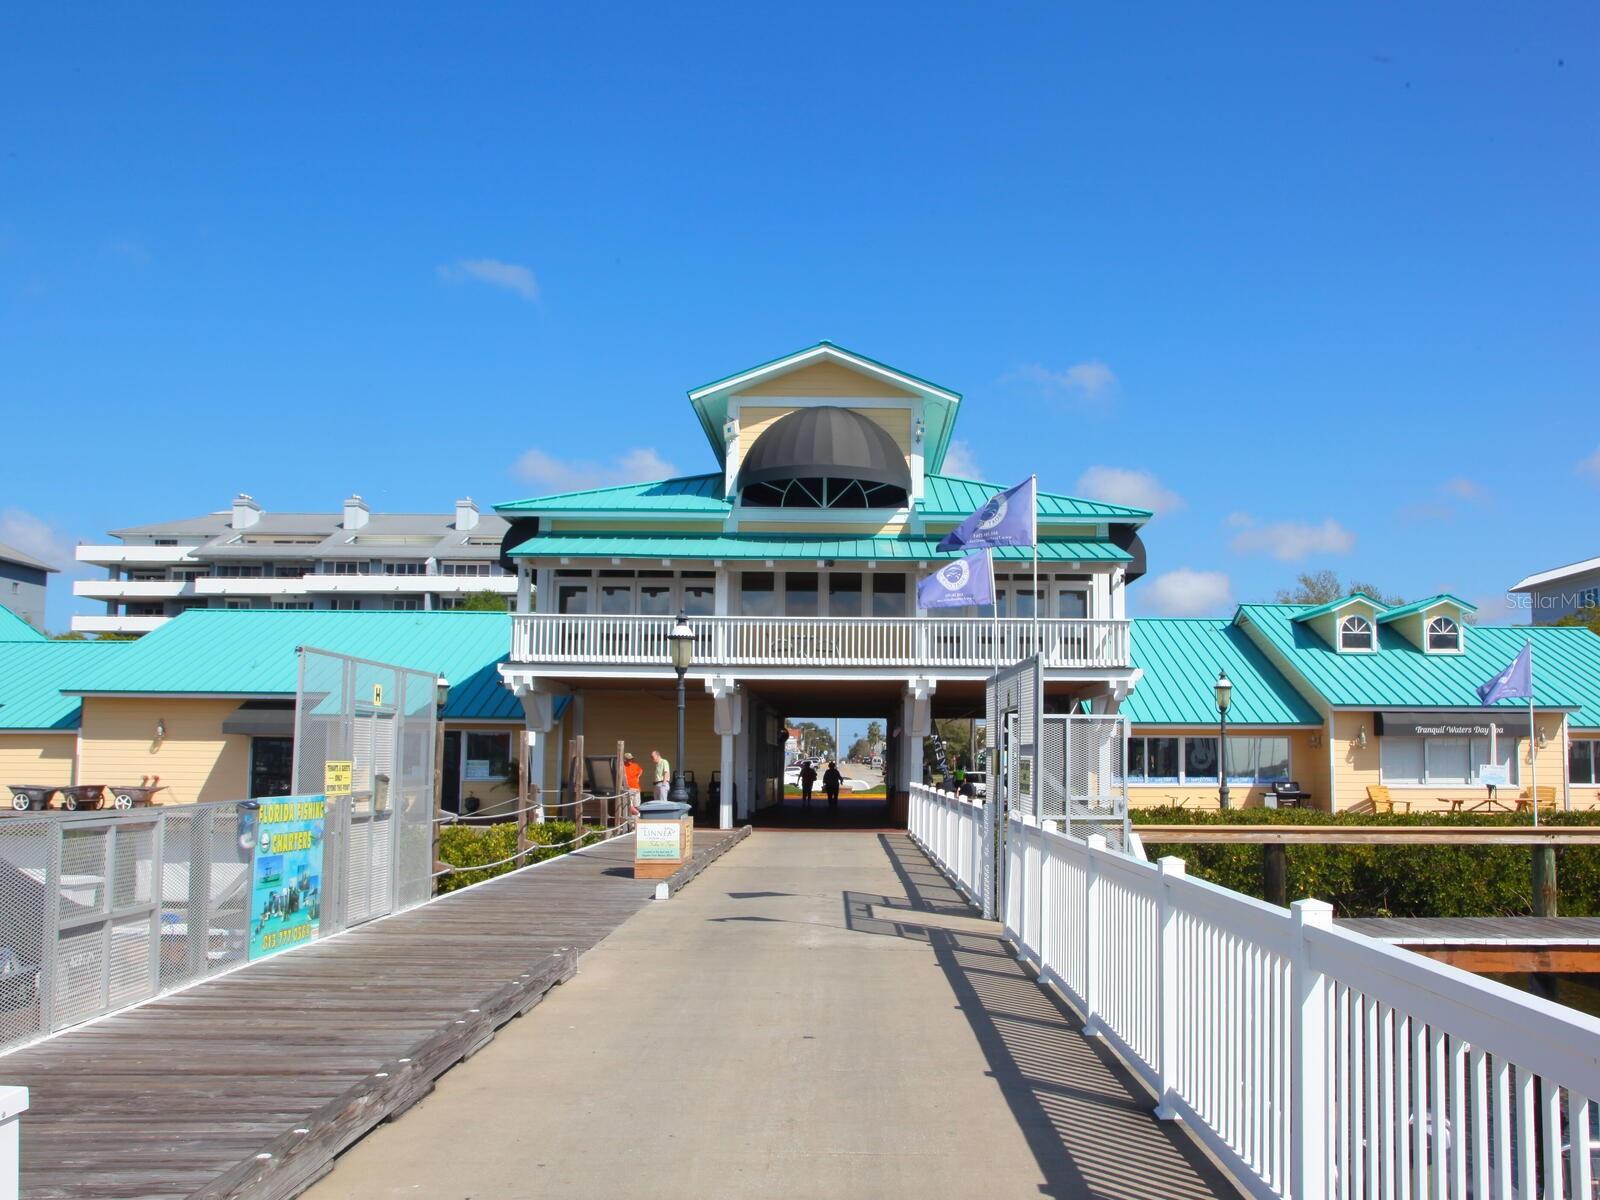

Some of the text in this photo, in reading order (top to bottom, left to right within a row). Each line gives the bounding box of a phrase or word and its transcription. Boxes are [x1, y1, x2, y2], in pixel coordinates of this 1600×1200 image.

[1415, 725, 1445, 735] Tranquil
[1446, 726, 1472, 734] Waters
[1473, 726, 1490, 736] Day
[258, 801, 324, 824] FLORIDA FISHING
[271, 831, 312, 854] CHARTERS
